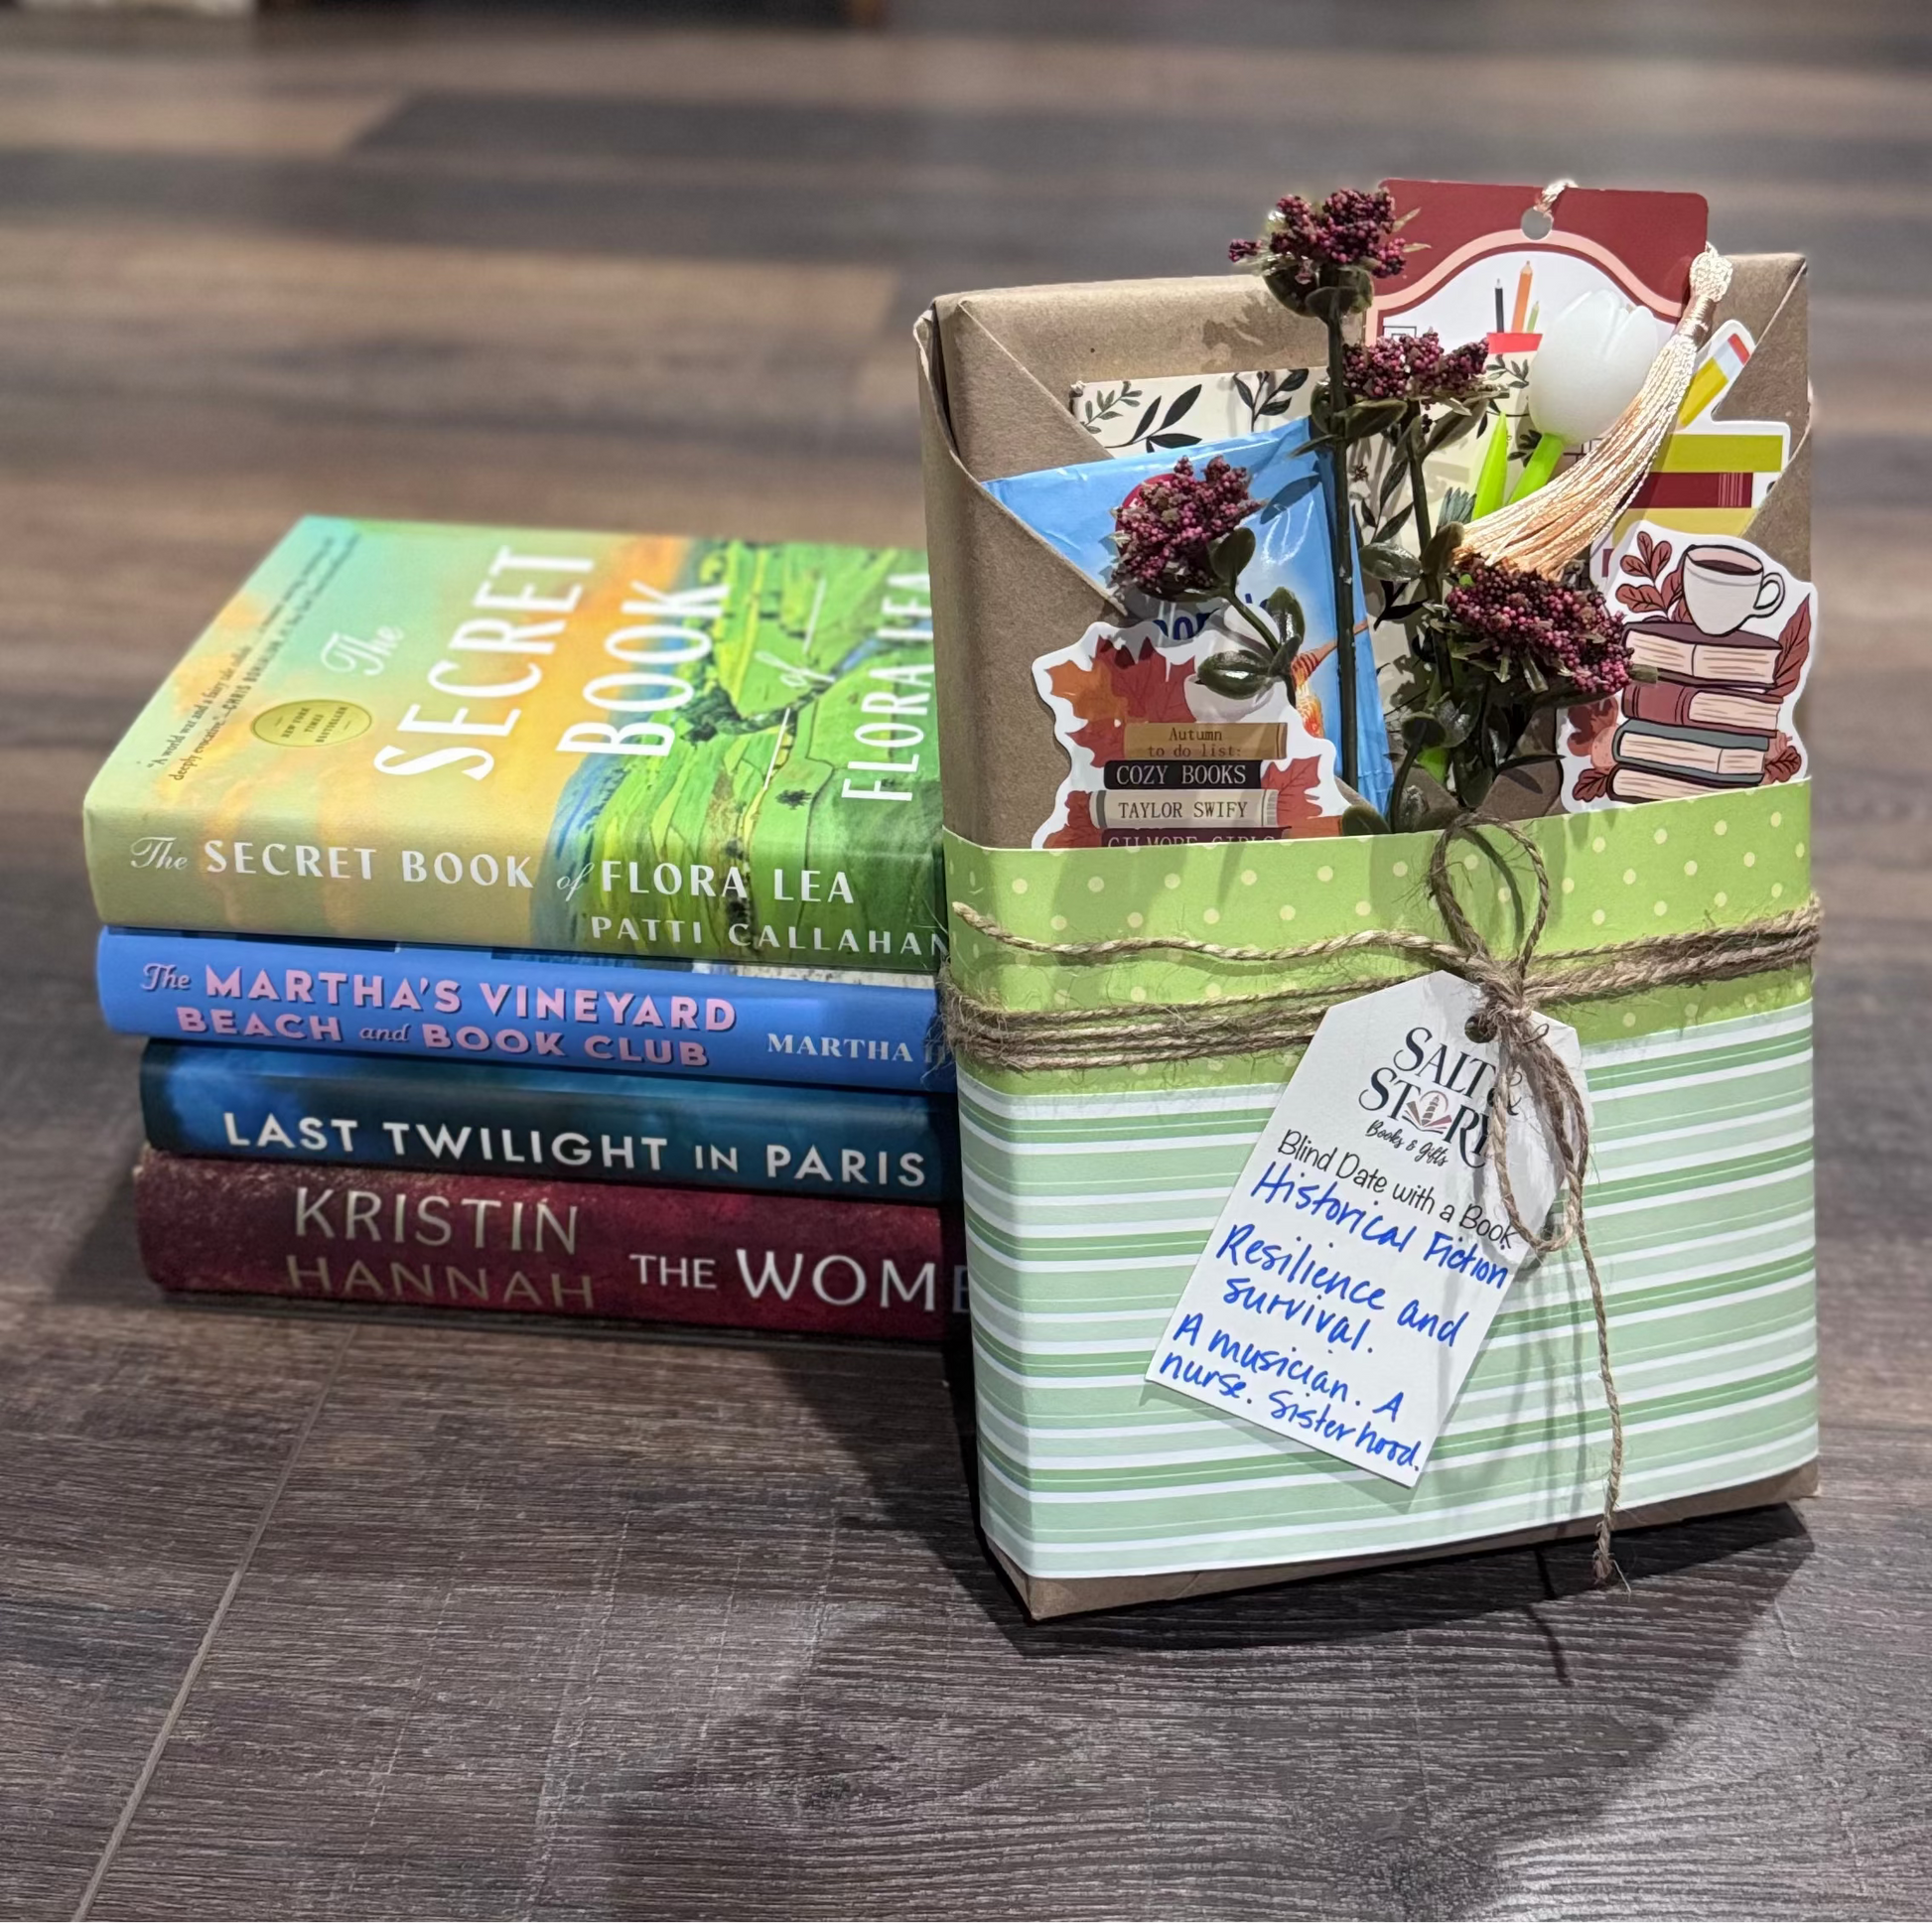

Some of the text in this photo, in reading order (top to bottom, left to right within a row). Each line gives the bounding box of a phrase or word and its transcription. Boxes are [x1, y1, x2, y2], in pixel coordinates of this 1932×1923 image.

[320, 625, 404, 676] The
[373, 546, 593, 780] SECRET
[555, 581, 731, 756] BOOK
[755, 650, 836, 689] of
[841, 663, 935, 801] FLORA
[1148, 744, 1241, 757] to do list:
[1169, 727, 1223, 742] Autumn
[1116, 764, 1247, 785] COZY BOOKS
[1118, 801, 1248, 819] TAYLOR SWIFY
[130, 836, 855, 904] The SECRET BOOK of FLORA LEA
[591, 916, 949, 956] PATTI CALLAHAN
[140, 962, 738, 1032] The MARTHA'S VINEYARD
[177, 1007, 711, 1068] BEACH and BOOK CLUB
[767, 1032, 914, 1063] MARTHA
[1393, 1027, 1497, 1100] SALT
[223, 1111, 926, 1188] LAST TWILIGHT IN PARIS
[1365, 1119, 1449, 1168] Books & Gifts
[296, 1186, 579, 1257] KRISTIN
[1278, 1129, 1517, 1251] Blind Date with a Book
[1250, 1162, 1510, 1291] Historical Fiction
[286, 1254, 594, 1309] HANNAH
[629, 1253, 717, 1291] THE
[1216, 1224, 1470, 1348] Resilience and
[1222, 1277, 1374, 1354] survival.
[1159, 1351, 1253, 1406] nurse.
[1173, 1312, 1405, 1423] A musician. A
